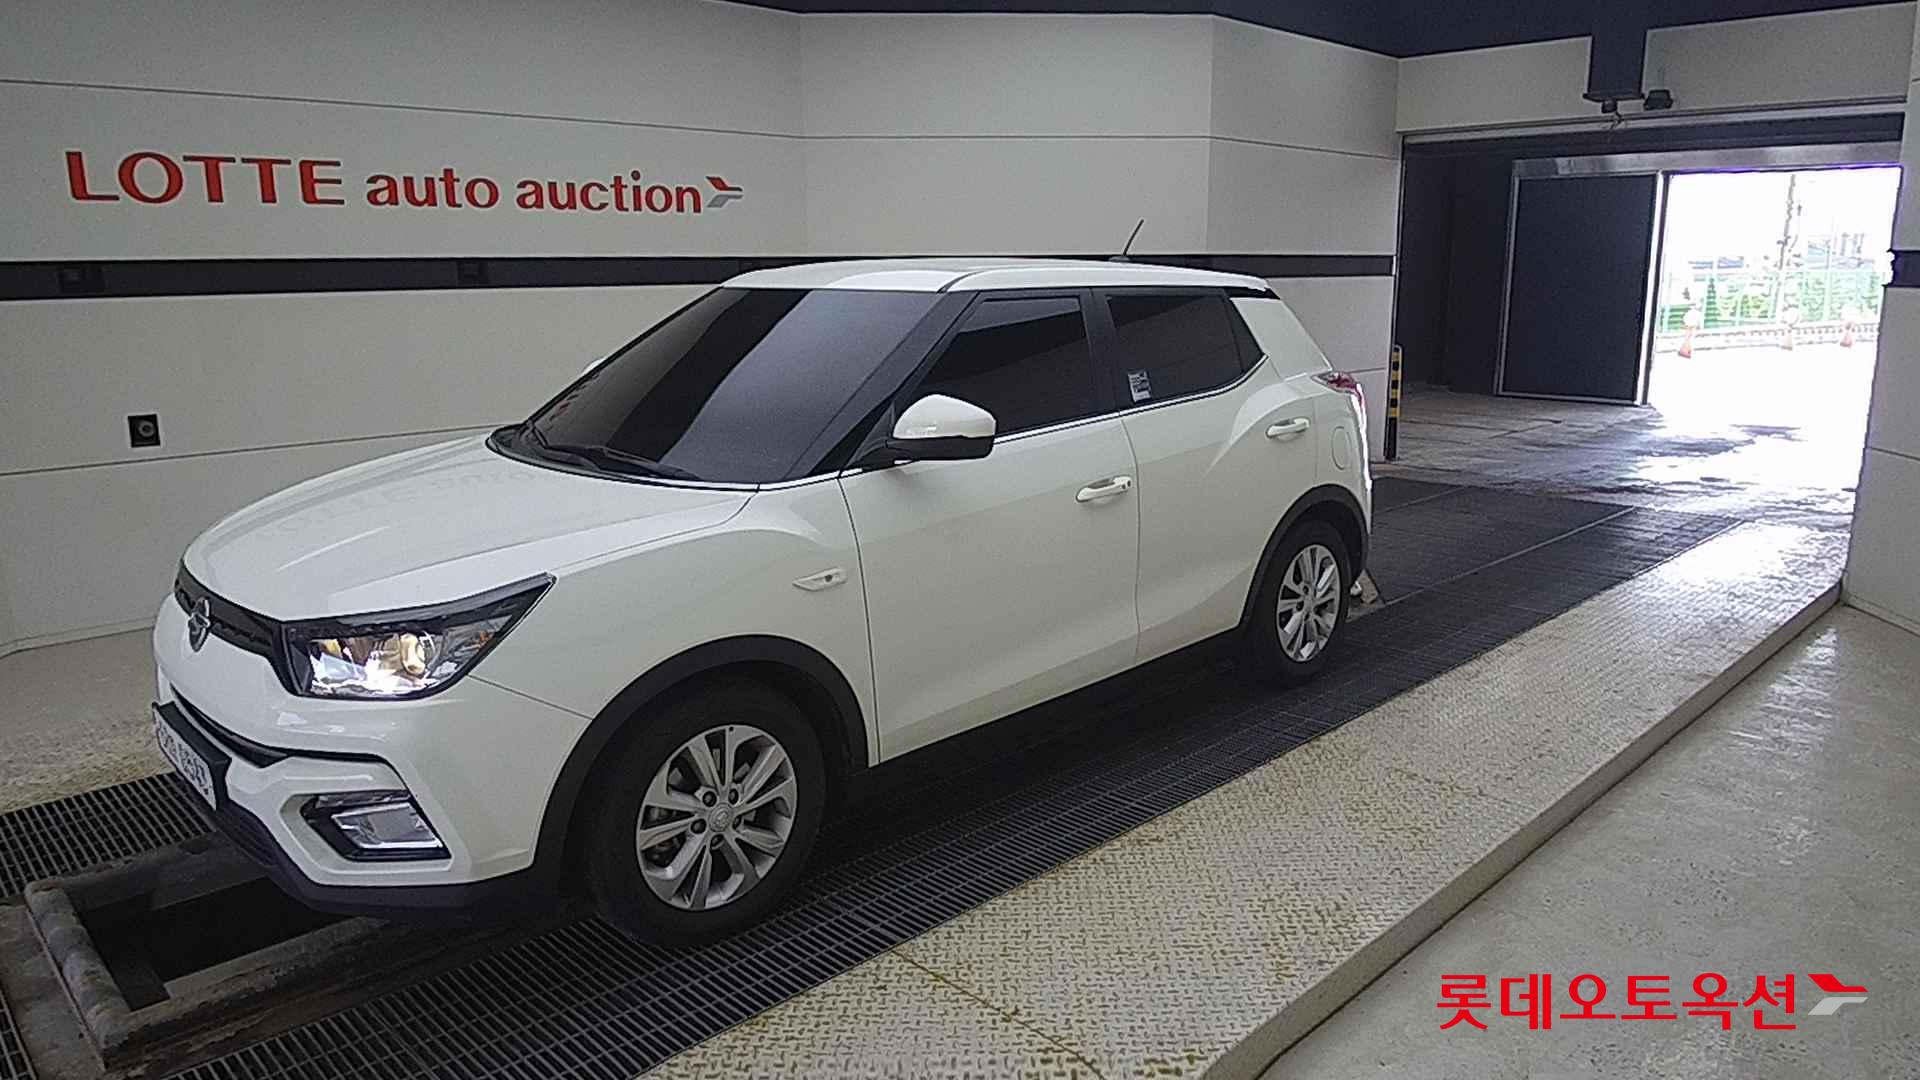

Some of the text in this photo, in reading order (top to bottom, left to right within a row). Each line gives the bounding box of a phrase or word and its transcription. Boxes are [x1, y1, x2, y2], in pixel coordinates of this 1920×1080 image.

[66, 151, 702, 213] LOTTE auto auction
